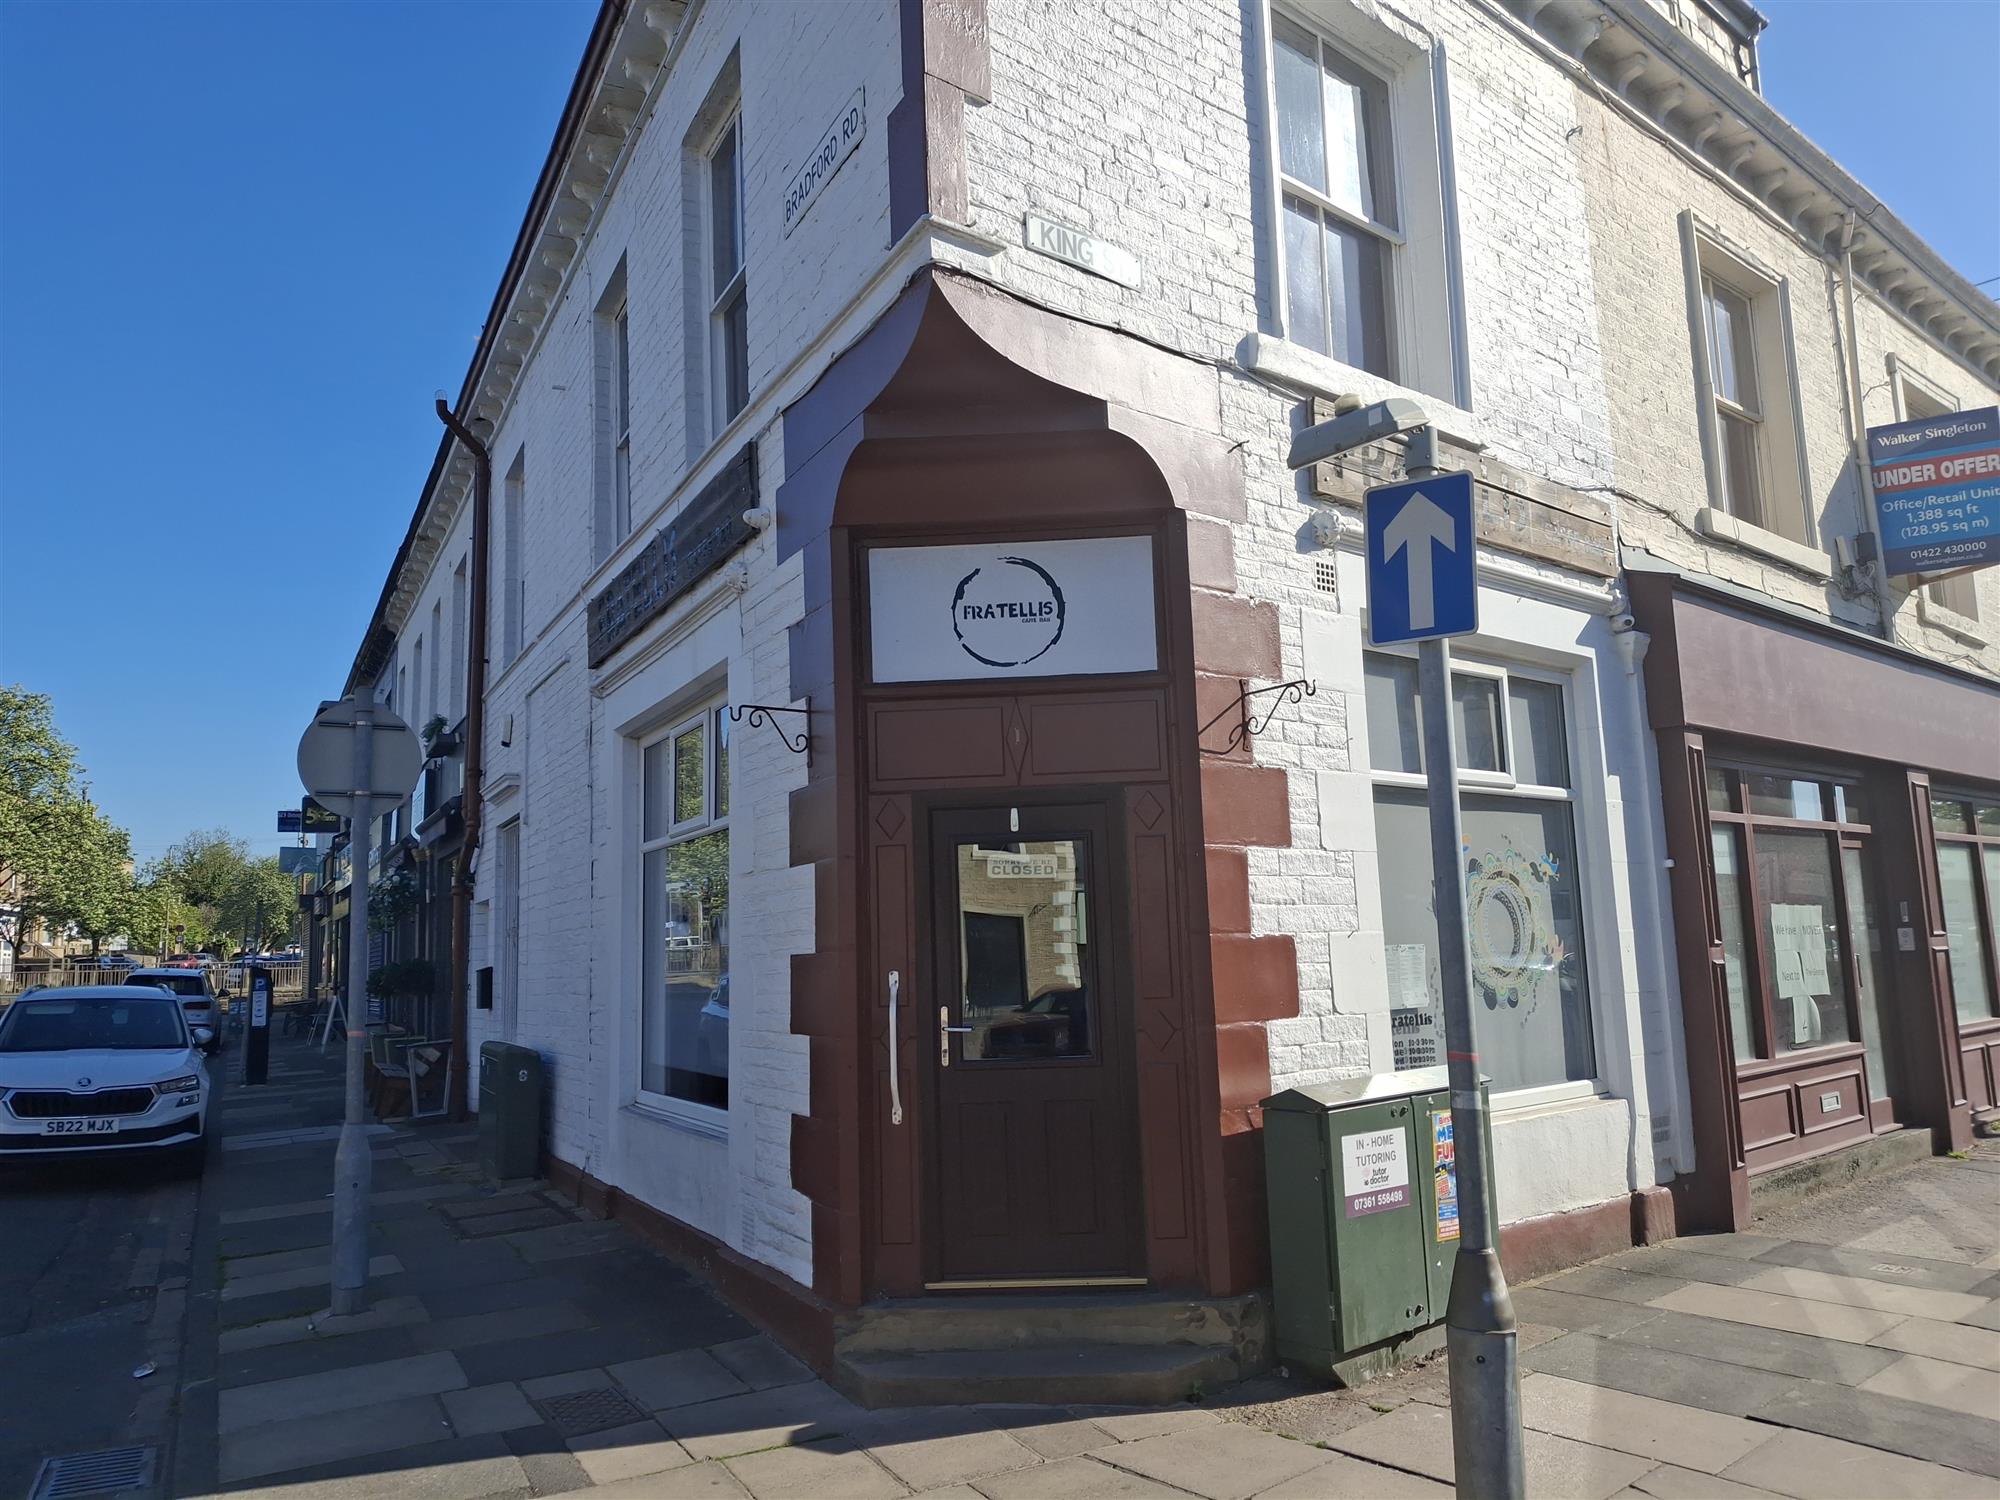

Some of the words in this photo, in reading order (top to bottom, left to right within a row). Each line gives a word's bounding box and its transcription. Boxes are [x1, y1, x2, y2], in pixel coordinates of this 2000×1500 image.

[785, 135, 837, 223] BRADFORD
[842, 107, 859, 145] RD
[1040, 221, 1094, 266] KING
[1877, 432, 1922, 447] Walker
[1925, 422, 1987, 439] Singleton
[1872, 463, 1936, 489] UNDER
[1940, 453, 2000, 479] OFFER
[1881, 490, 1967, 513] Office/Retail
[1906, 508, 1943, 525] 1,388
[1947, 509, 1963, 518] sq
[1966, 503, 1980, 514] ft
[1901, 521, 1949, 540] (128.95
[1952, 523, 1969, 532] sq
[1972, 516, 1989, 529] m)
[1910, 547, 1941, 559] 01422
[1944, 541, 1987, 554] 430000
[963, 601, 1053, 620] FRATELLIS
[991, 865, 1055, 876] CLOSED
[1391, 1012, 1433, 1029] ratellis
[47, 1121, 83, 1133] SB22
[87, 1119, 114, 1132] MJX
[1355, 1139, 1365, 1150] IN
[1371, 1134, 1394, 1148] HOME
[1355, 1150, 1397, 1168] TUTORING
[1369, 1174, 1390, 1185] doctor
[1372, 1167, 1387, 1176] tutor
[1354, 1195, 1376, 1211] 07361
